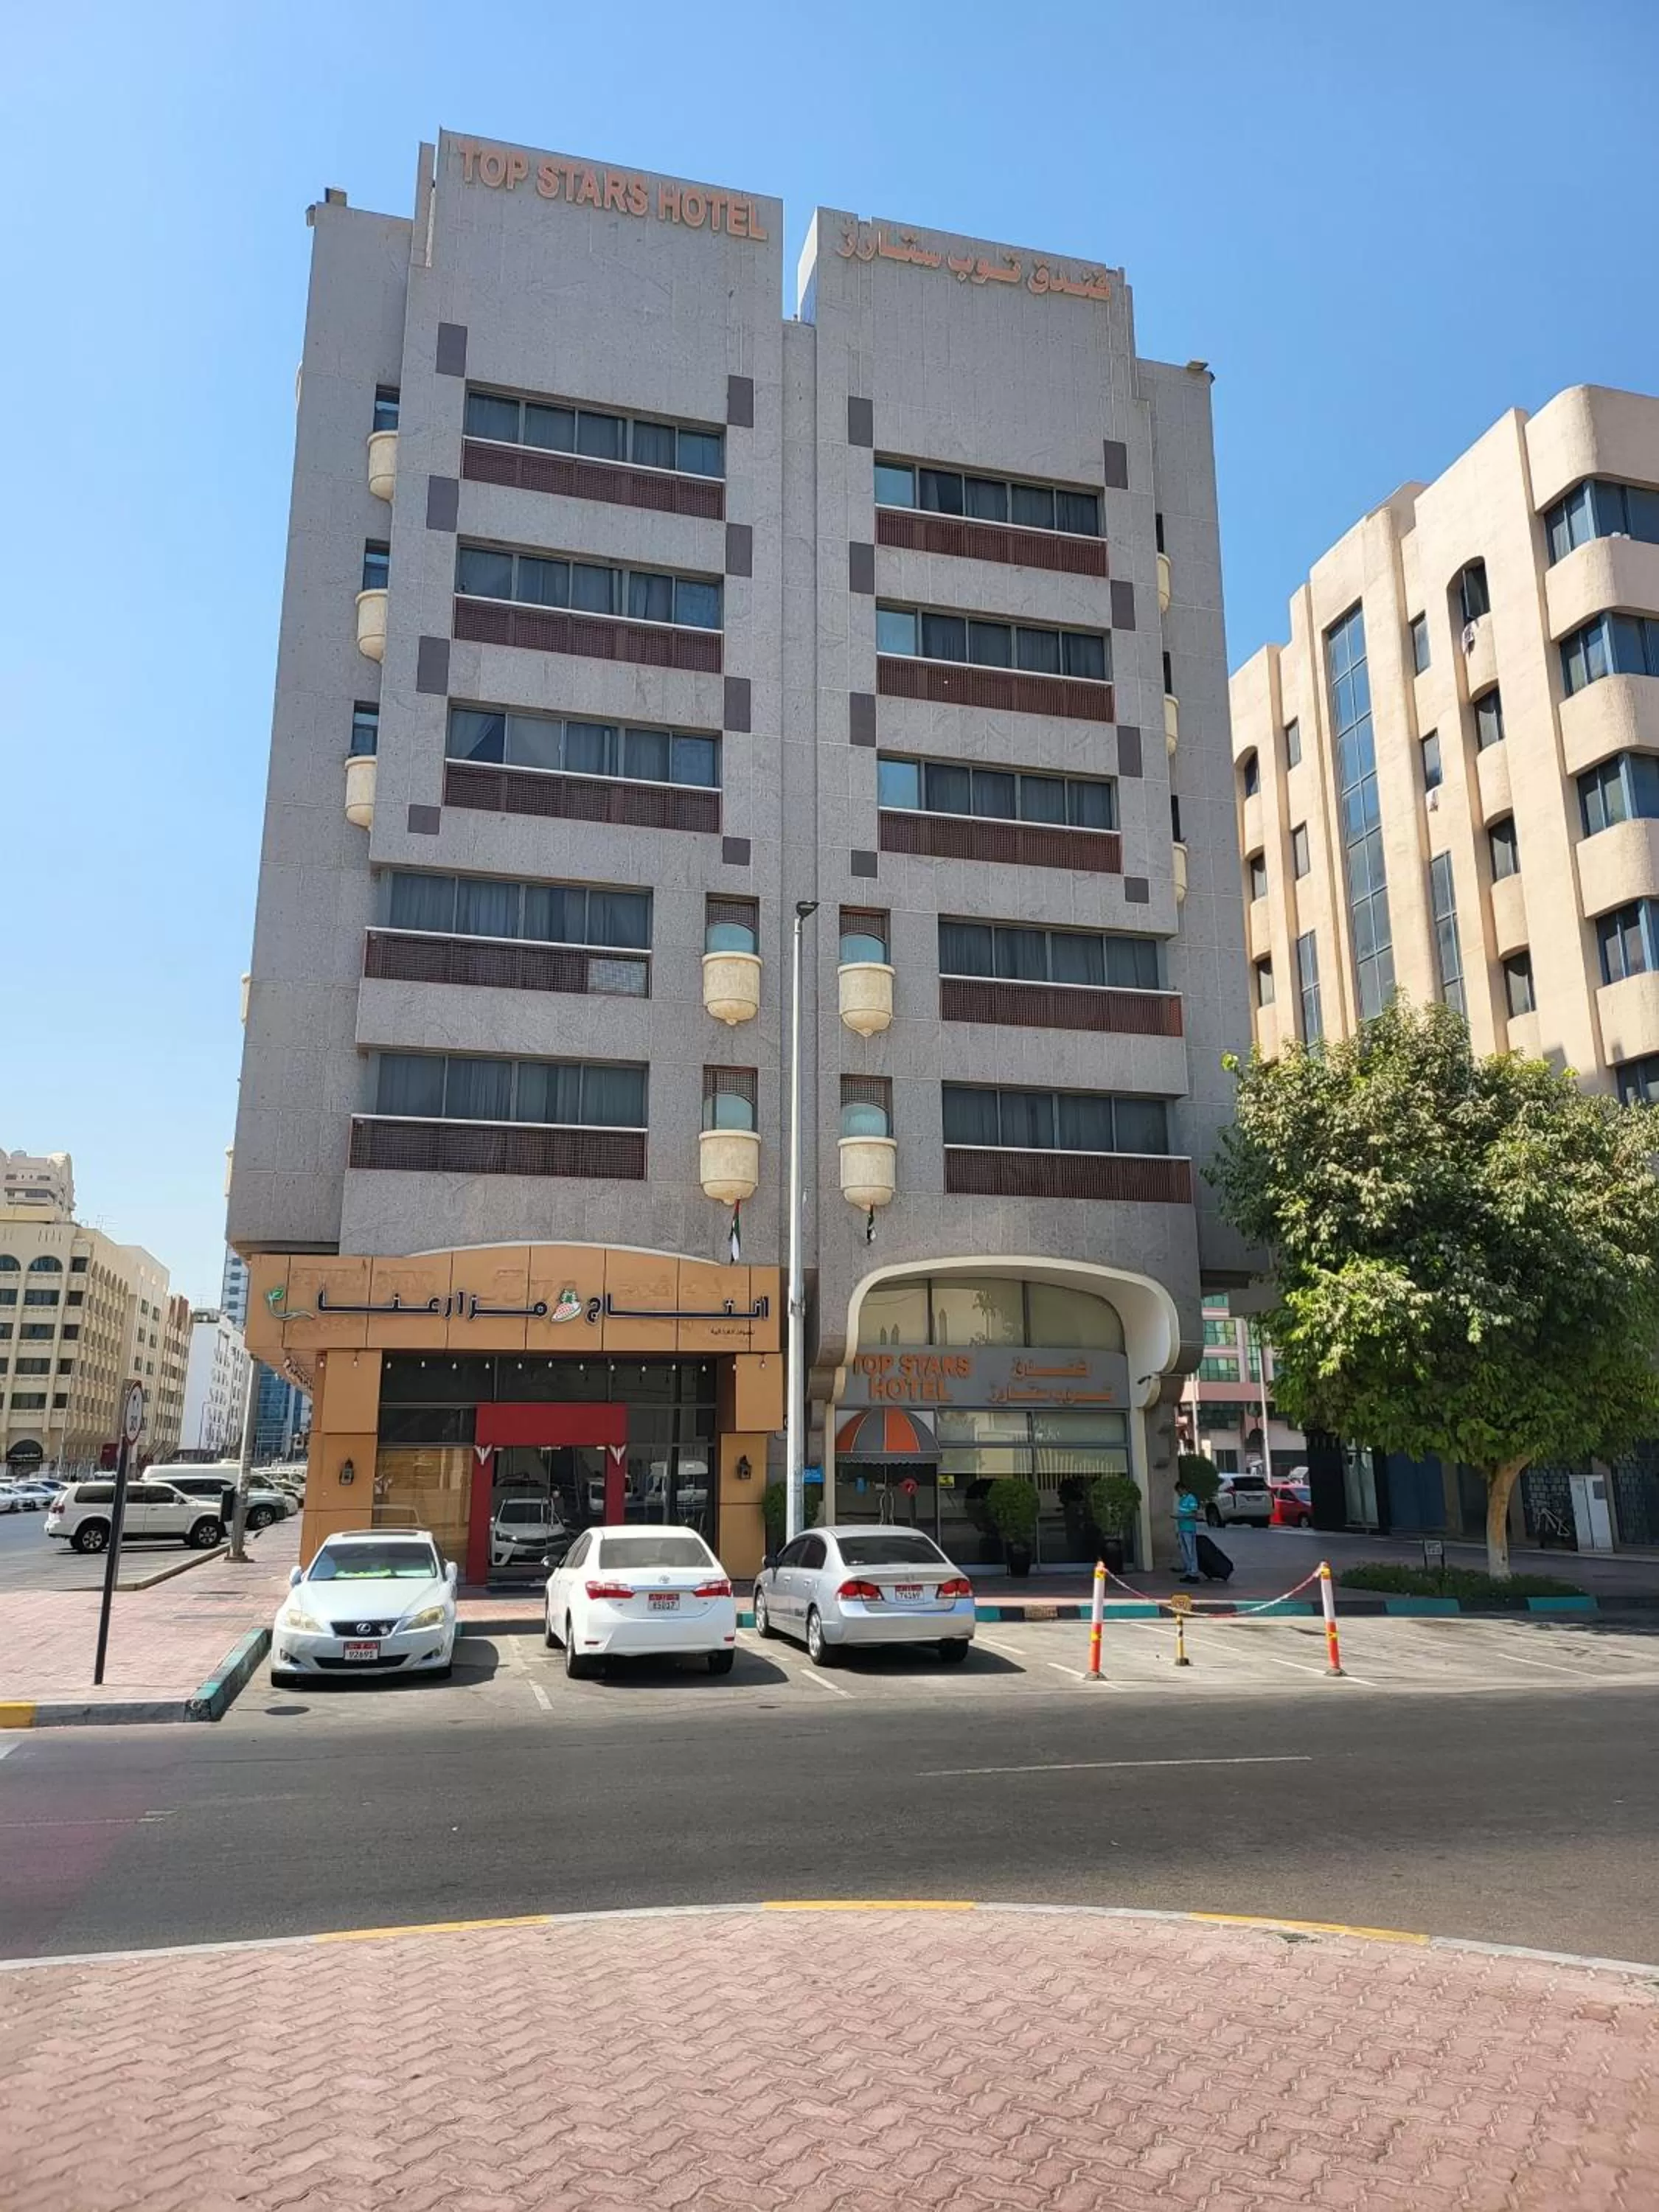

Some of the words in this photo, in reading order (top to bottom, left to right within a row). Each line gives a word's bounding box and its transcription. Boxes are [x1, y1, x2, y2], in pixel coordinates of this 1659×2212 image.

[458, 140, 529, 191] TOP
[536, 158, 649, 218] STARS
[658, 183, 768, 242] HOTEL
[836, 221, 942, 268] ستارز
[1027, 259, 1111, 301] فندق
[318, 1289, 548, 1320] مزارعنا
[585, 1292, 769, 1325] انتاج
[852, 1353, 893, 1377] TOP
[897, 1353, 973, 1378] STARS
[867, 1377, 954, 1402] HOTEL
